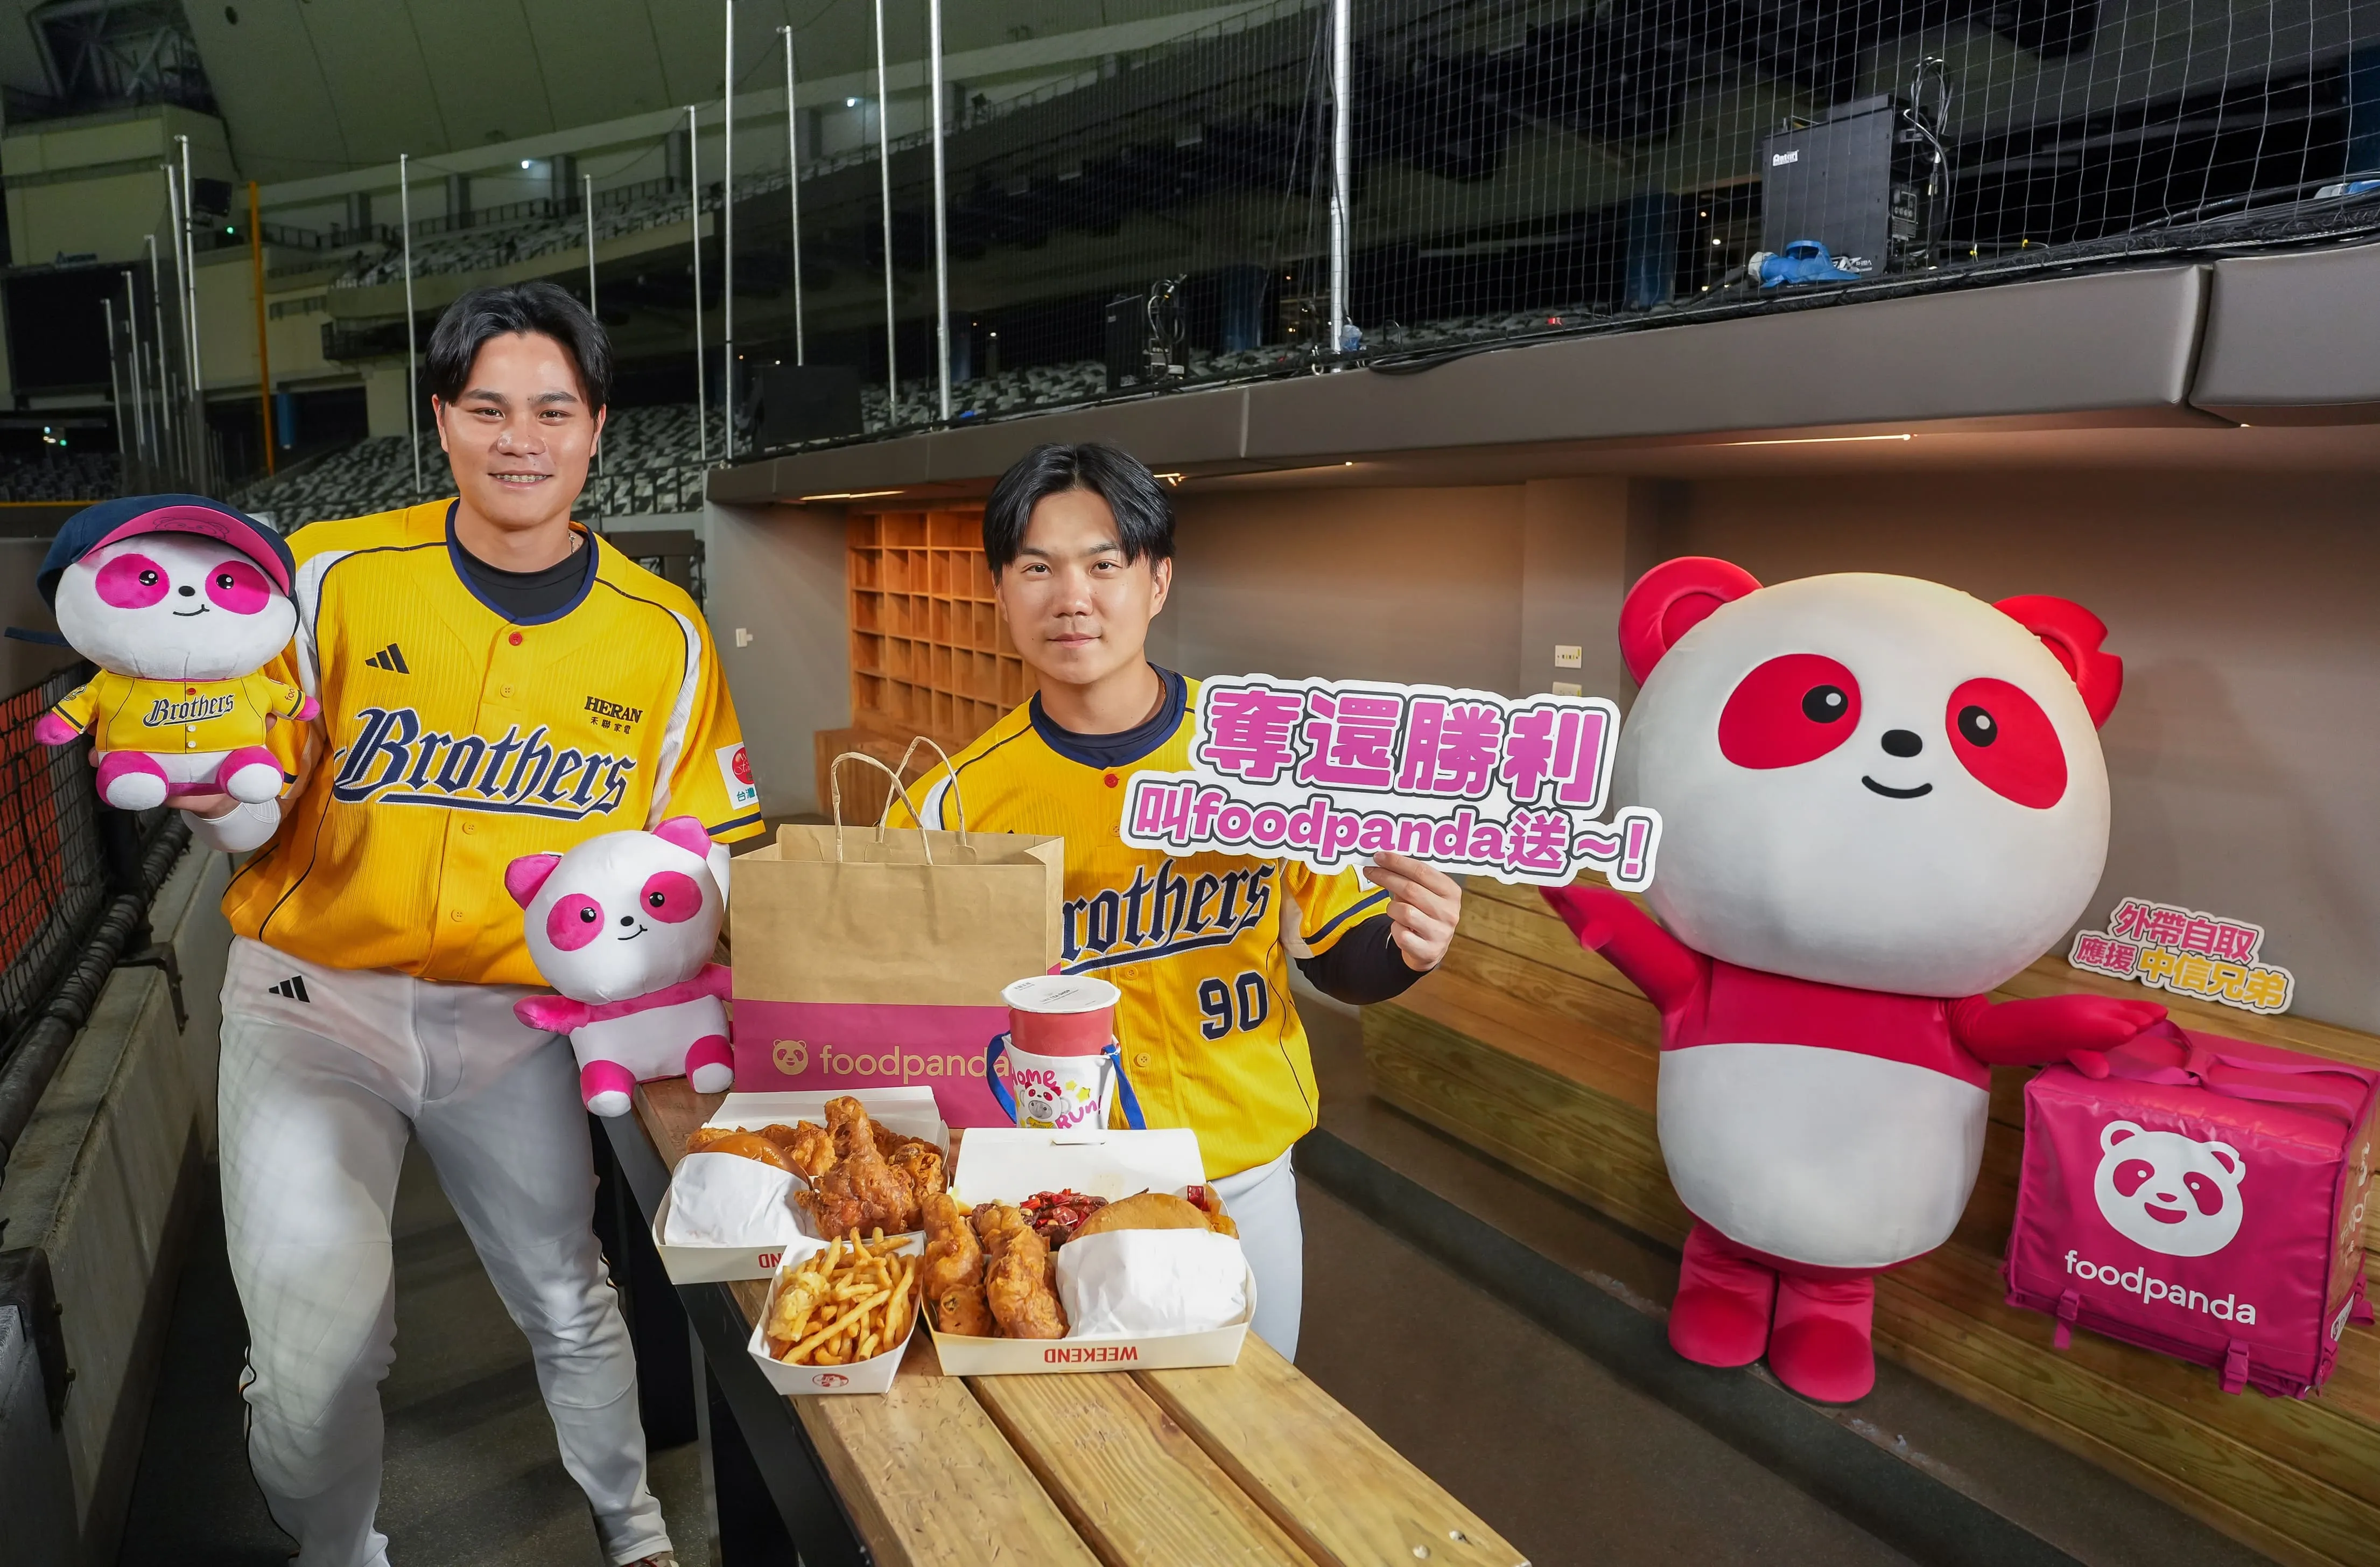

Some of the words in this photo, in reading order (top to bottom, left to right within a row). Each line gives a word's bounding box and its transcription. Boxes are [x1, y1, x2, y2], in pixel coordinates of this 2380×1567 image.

[142, 693, 235, 727] Brothers
[584, 696, 643, 723] HERAN
[333, 706, 637, 821] Brothers
[1204, 687, 1609, 803] 奪還勝利
[1061, 857, 1276, 964] rothers
[2114, 903, 2257, 963] 外帶自取
[1197, 970, 1269, 1041] 90
[819, 1044, 1010, 1085] foodpanda
[2064, 1250, 2257, 1326] foodpanda
[1044, 1346, 1138, 1363] WEEKEND
